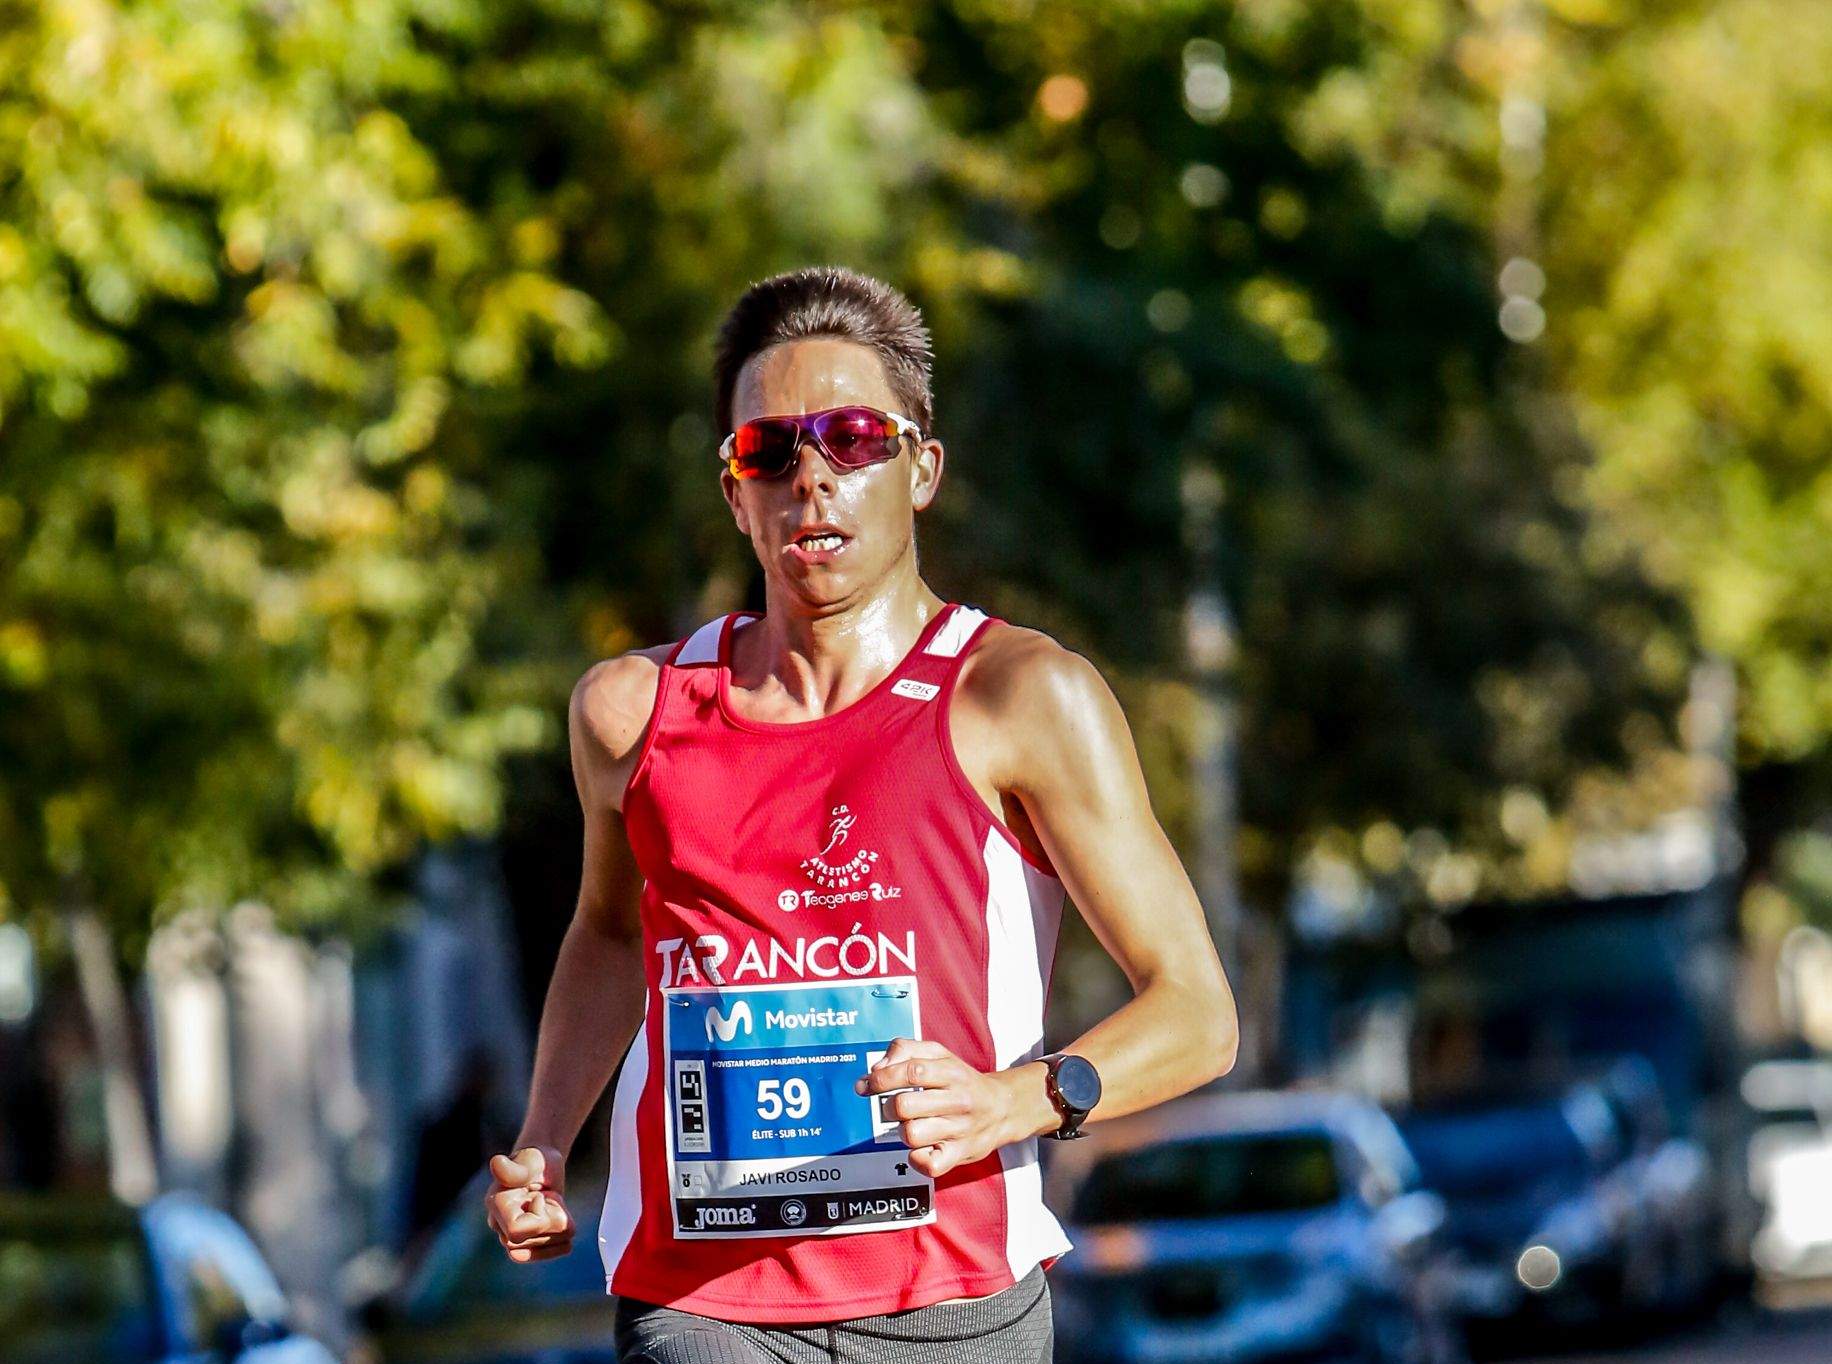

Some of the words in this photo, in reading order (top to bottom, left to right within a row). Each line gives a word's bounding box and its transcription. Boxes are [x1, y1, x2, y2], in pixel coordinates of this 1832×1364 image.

[810, 849, 868, 876] ATLETISMO
[781, 894, 797, 906] TR
[869, 882, 901, 901] Ruiz
[656, 922, 917, 987] TARANCÓN
[765, 1008, 859, 1030] Movistar
[712, 1060, 744, 1068] MOVISTAR
[745, 1059, 769, 1067] MEDIO
[770, 1056, 808, 1066] MARATÓN
[809, 1055, 839, 1064] MADRID
[840, 1054, 857, 1062] 2021
[757, 1078, 811, 1120] 59
[752, 1128, 774, 1140] ÉLITE
[779, 1129, 796, 1139] SUB
[798, 1128, 808, 1137] 1h
[739, 1173, 771, 1186] JAVI
[776, 1169, 841, 1184] ROSADO
[849, 1198, 919, 1216] MADRID
